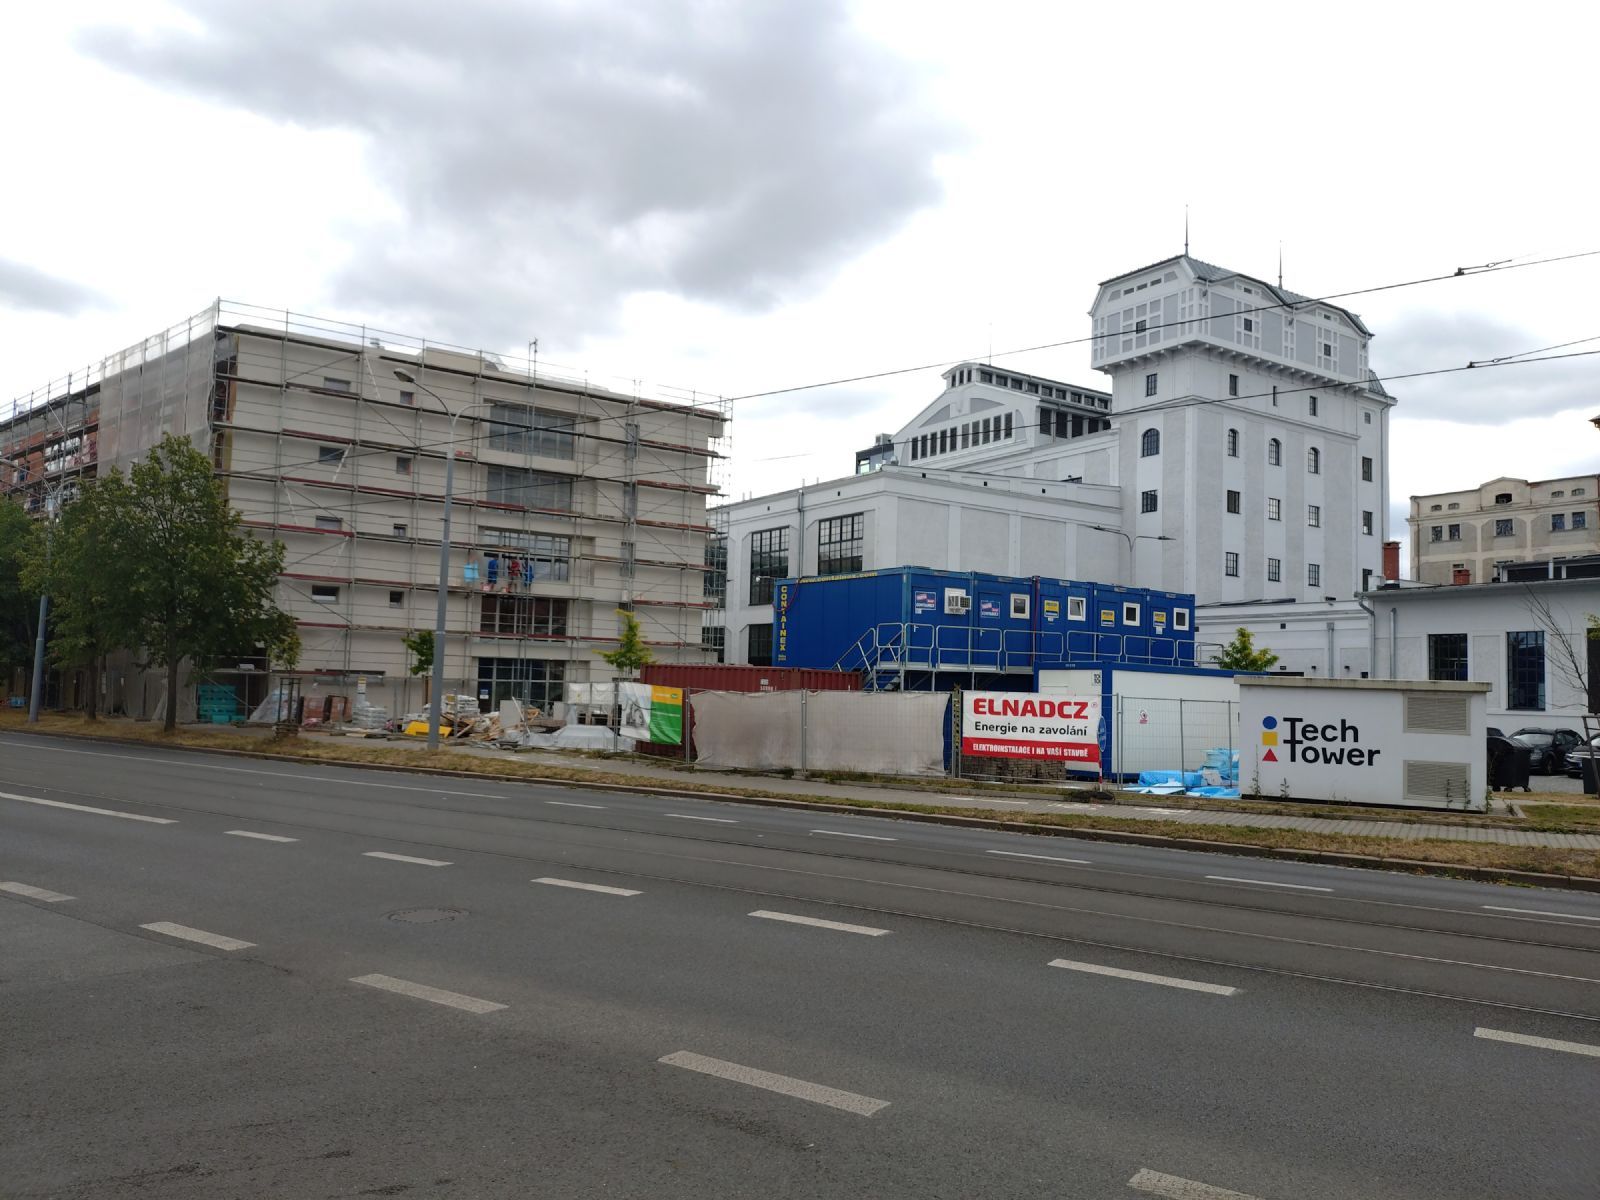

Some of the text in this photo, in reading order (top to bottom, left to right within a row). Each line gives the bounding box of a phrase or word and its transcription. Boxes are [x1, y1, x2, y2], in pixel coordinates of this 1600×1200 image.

[973, 698, 1089, 720] ELNADCZ
[975, 721, 1088, 736] Energie na zavolání
[1282, 717, 1359, 743] Tech
[973, 743, 1031, 755] ELEKTROINSTALACE
[1046, 747, 1062, 757] VAŠÍ
[1282, 740, 1381, 766] Tower
